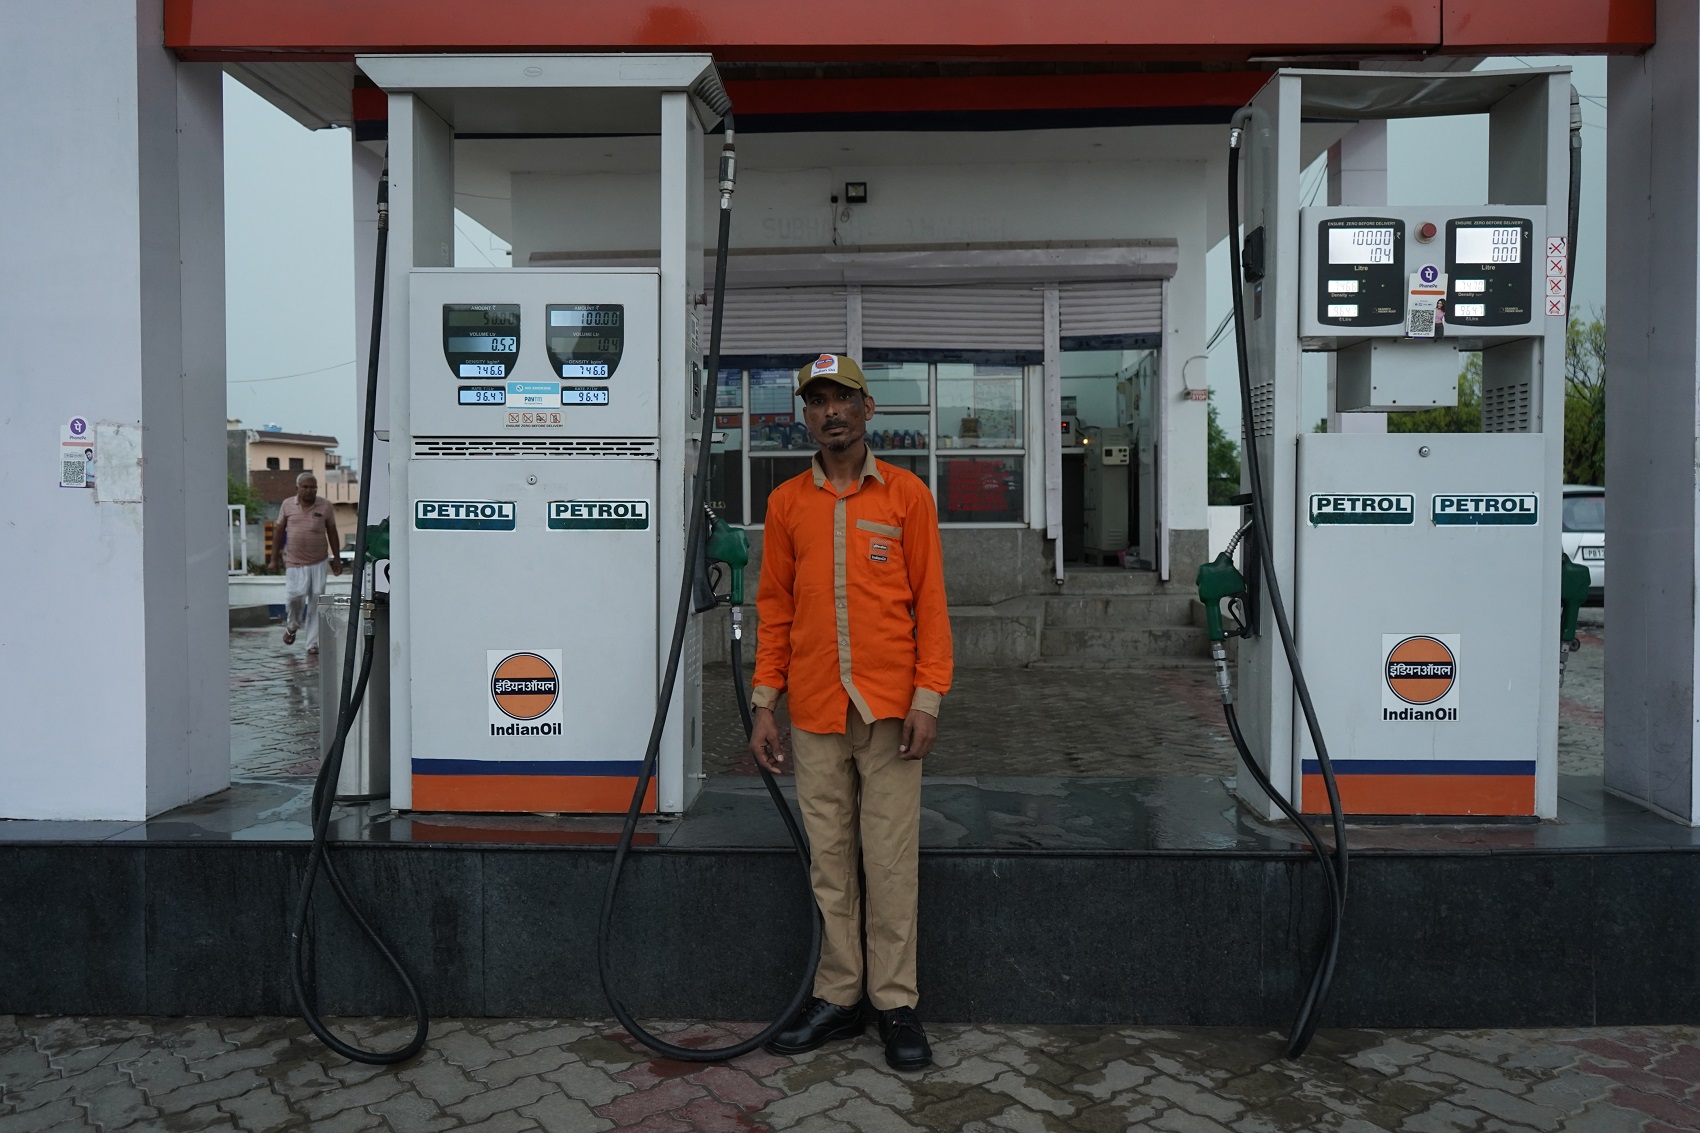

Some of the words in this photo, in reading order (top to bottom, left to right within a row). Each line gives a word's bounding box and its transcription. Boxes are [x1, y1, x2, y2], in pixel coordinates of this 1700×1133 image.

[1352, 231, 1391, 245] 100.00
[1492, 230, 1518, 245] 0.00
[1492, 247, 1518, 262] 0.00
[581, 312, 618, 325] 100.00
[491, 338, 515, 351] 0.52
[477, 366, 503, 375] 746.6
[580, 366, 606, 375] 746.6
[476, 392, 503, 401] 96.47
[578, 392, 606, 401] 96.47
[555, 503, 642, 517] PETROL
[1317, 497, 1408, 512] PETROL
[1440, 498, 1531, 512] PETROL
[422, 504, 510, 519] PETROL
[1588, 549, 1604, 557] PB1
[1389, 663, 1452, 678] इंडियनऑयल
[495, 679, 555, 694] इंडियनऑयल
[1383, 708, 1457, 720] IndianOil
[490, 723, 562, 736] IndianOil
